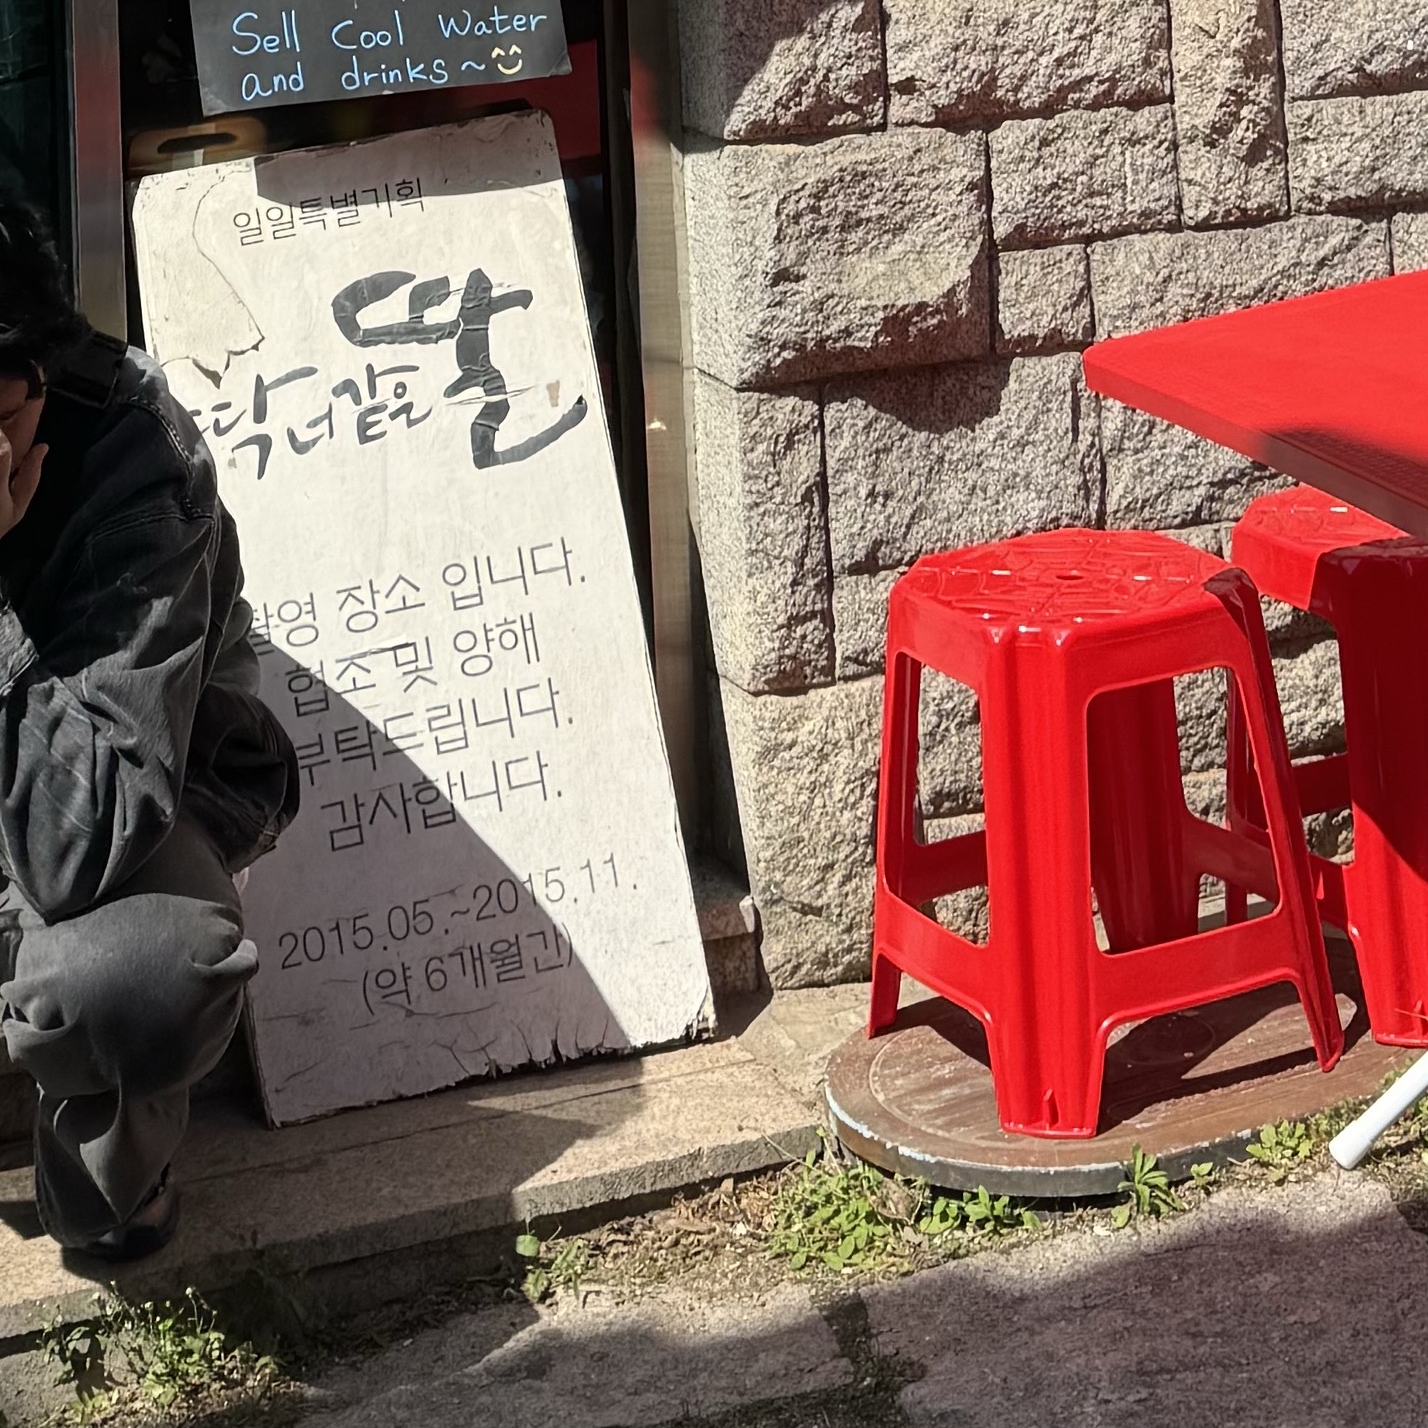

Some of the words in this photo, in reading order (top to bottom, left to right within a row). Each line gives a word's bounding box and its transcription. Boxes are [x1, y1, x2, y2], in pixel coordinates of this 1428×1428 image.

[232, 9, 300, 55] Sell
[438, 5, 548, 40] Water
[241, 61, 304, 102] and
[232, 177, 425, 246] 일일특별기획
[332, 267, 588, 470] 딸
[336, 573, 425, 633] 장소
[441, 537, 587, 611] 입니다.
[285, 654, 376, 718] 협조
[393, 635, 438, 694] 및
[452, 612, 542, 677] 양해
[294, 677, 575, 786] 부탁드립니다.
[320, 750, 564, 851] 감사합니다.
[279, 853, 639, 970] 2015.05.~2015.11.
[361, 958, 412, 1016] (약
[423, 922, 574, 995] 6개월간)
